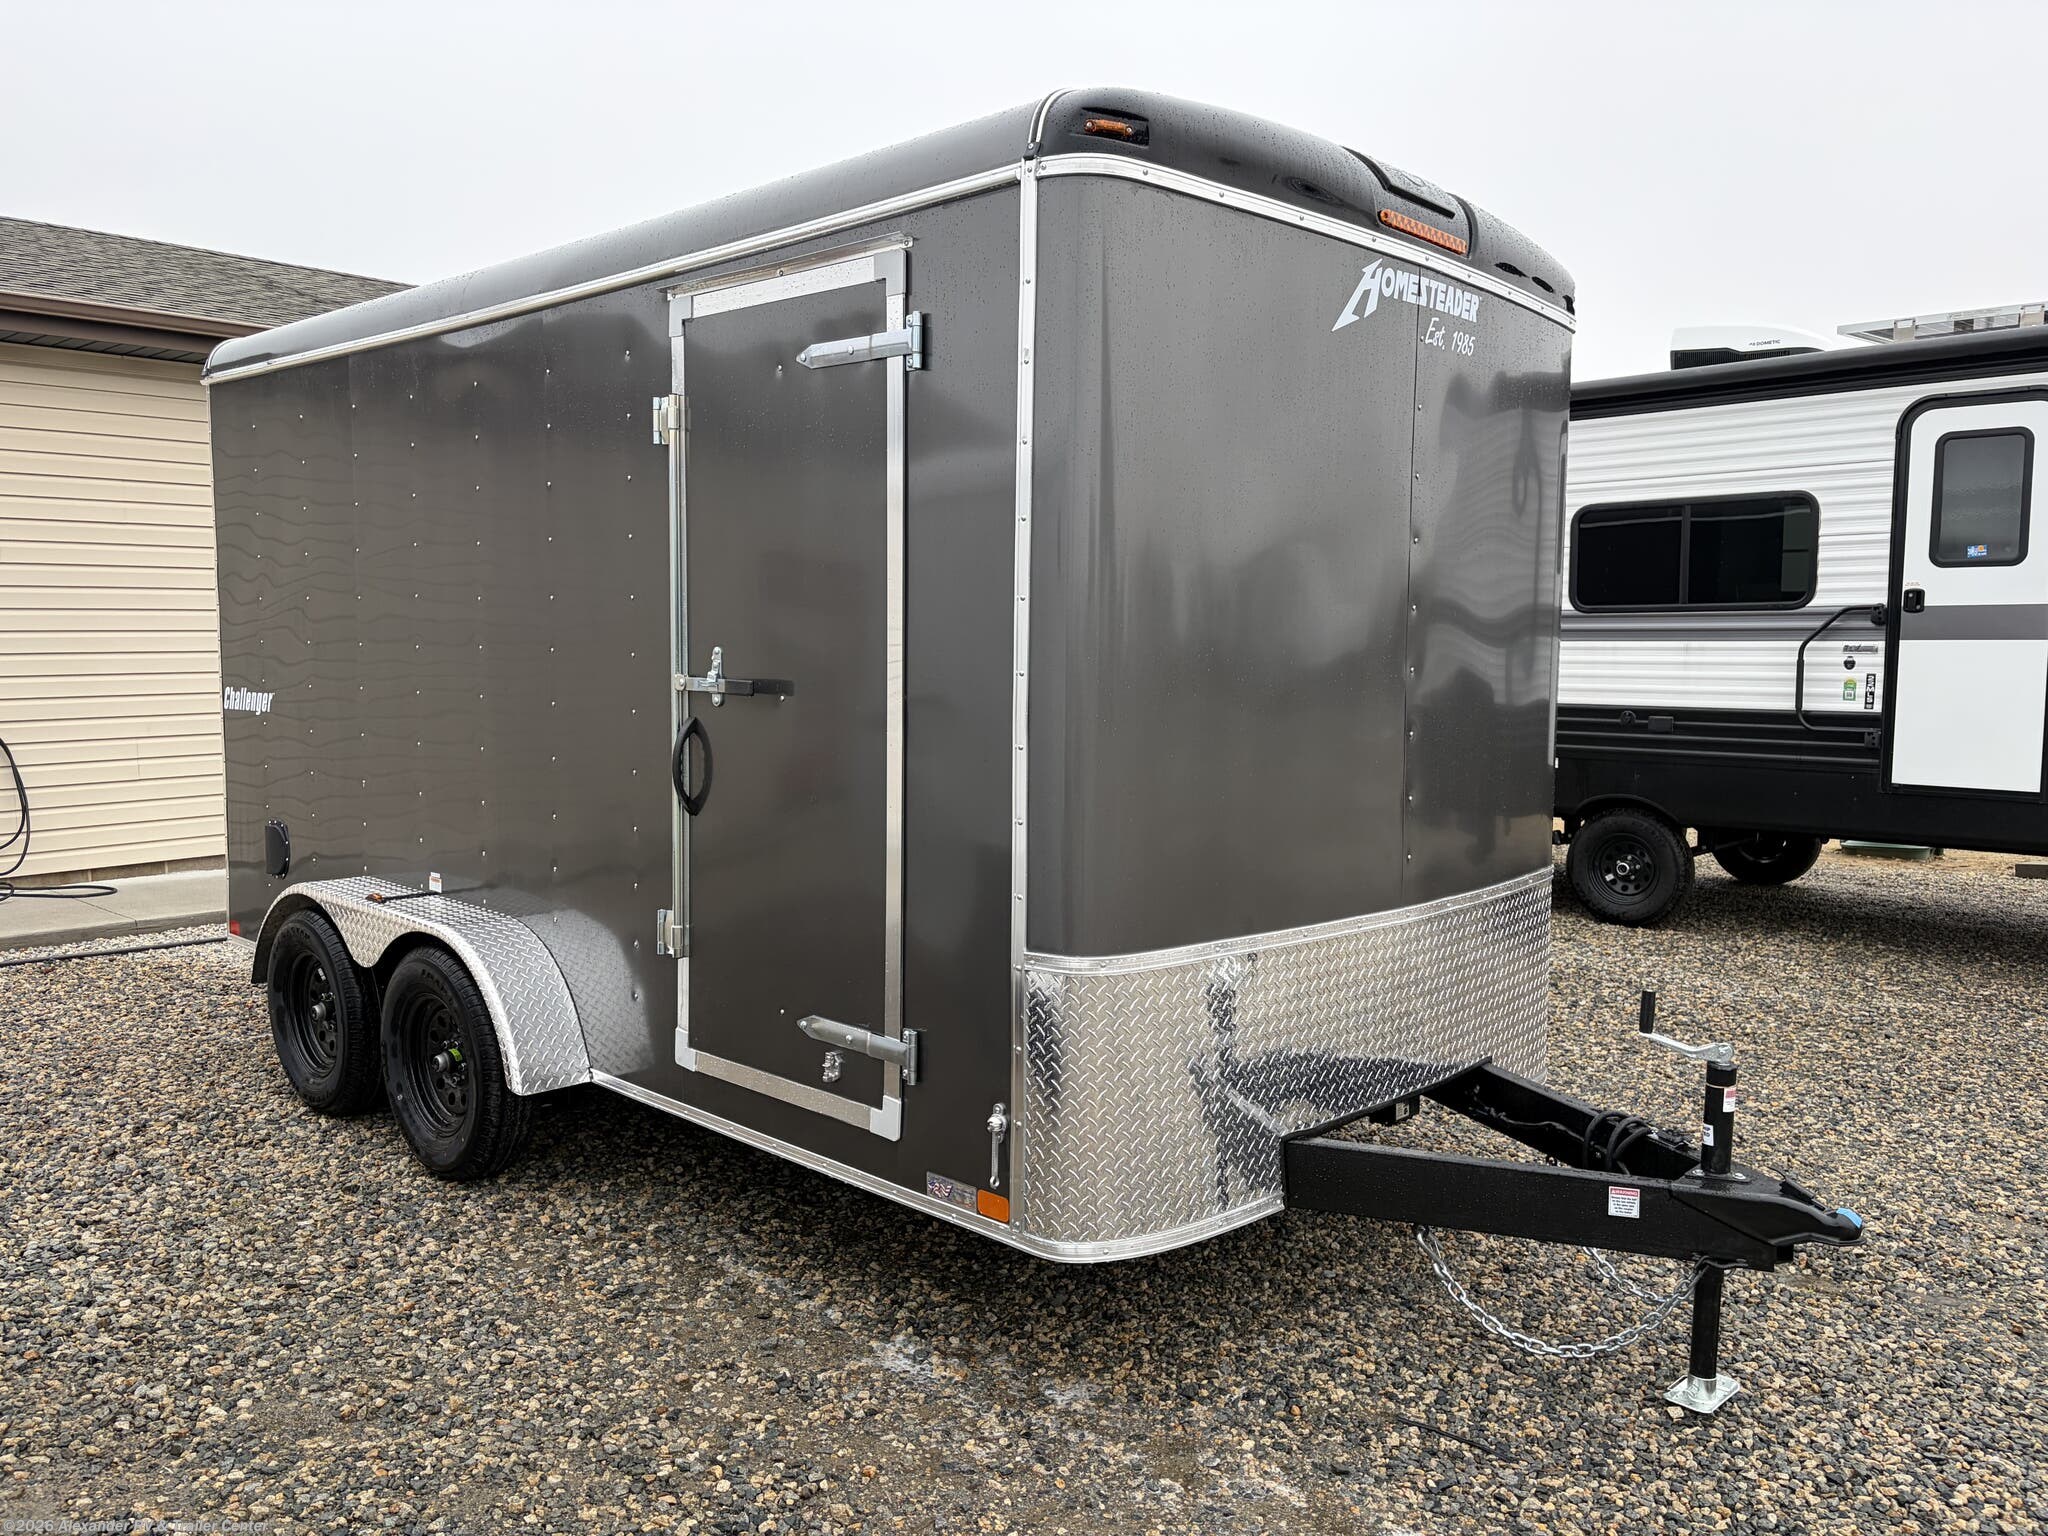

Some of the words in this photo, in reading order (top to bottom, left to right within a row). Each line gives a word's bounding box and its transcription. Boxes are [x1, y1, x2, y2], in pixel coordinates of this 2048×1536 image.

[1331, 258, 1480, 332] HOMESTEADER
[1451, 331, 1476, 357] 1985
[223, 686, 276, 716] Challenger
